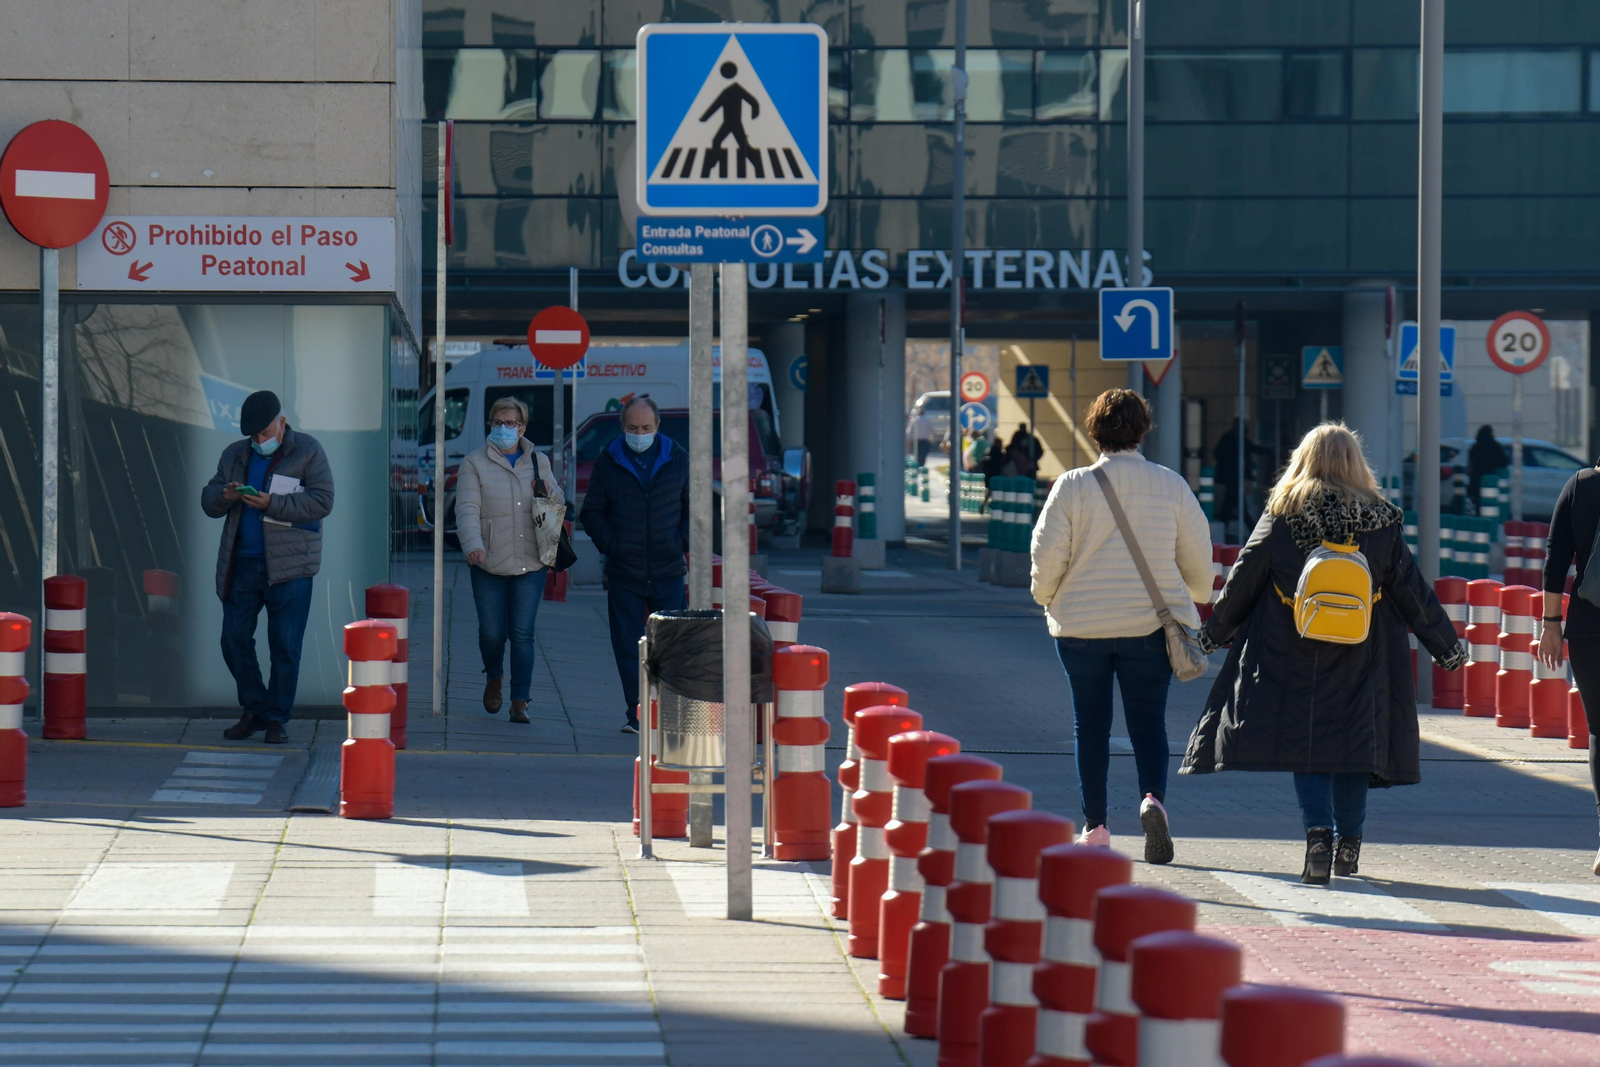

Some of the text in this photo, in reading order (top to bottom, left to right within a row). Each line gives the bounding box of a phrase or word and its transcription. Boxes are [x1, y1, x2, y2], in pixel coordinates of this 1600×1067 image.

[149, 224, 358, 246] Prohibido el Paso
[642, 225, 750, 239] Entrada Peatonal
[642, 242, 704, 256] Consultas
[202, 254, 306, 276] Peatonal
[907, 249, 1154, 289] EXTERNAS
[1502, 332, 1537, 352] 20
[587, 363, 646, 377] OLECTIVO
[966, 381, 983, 391] 20
